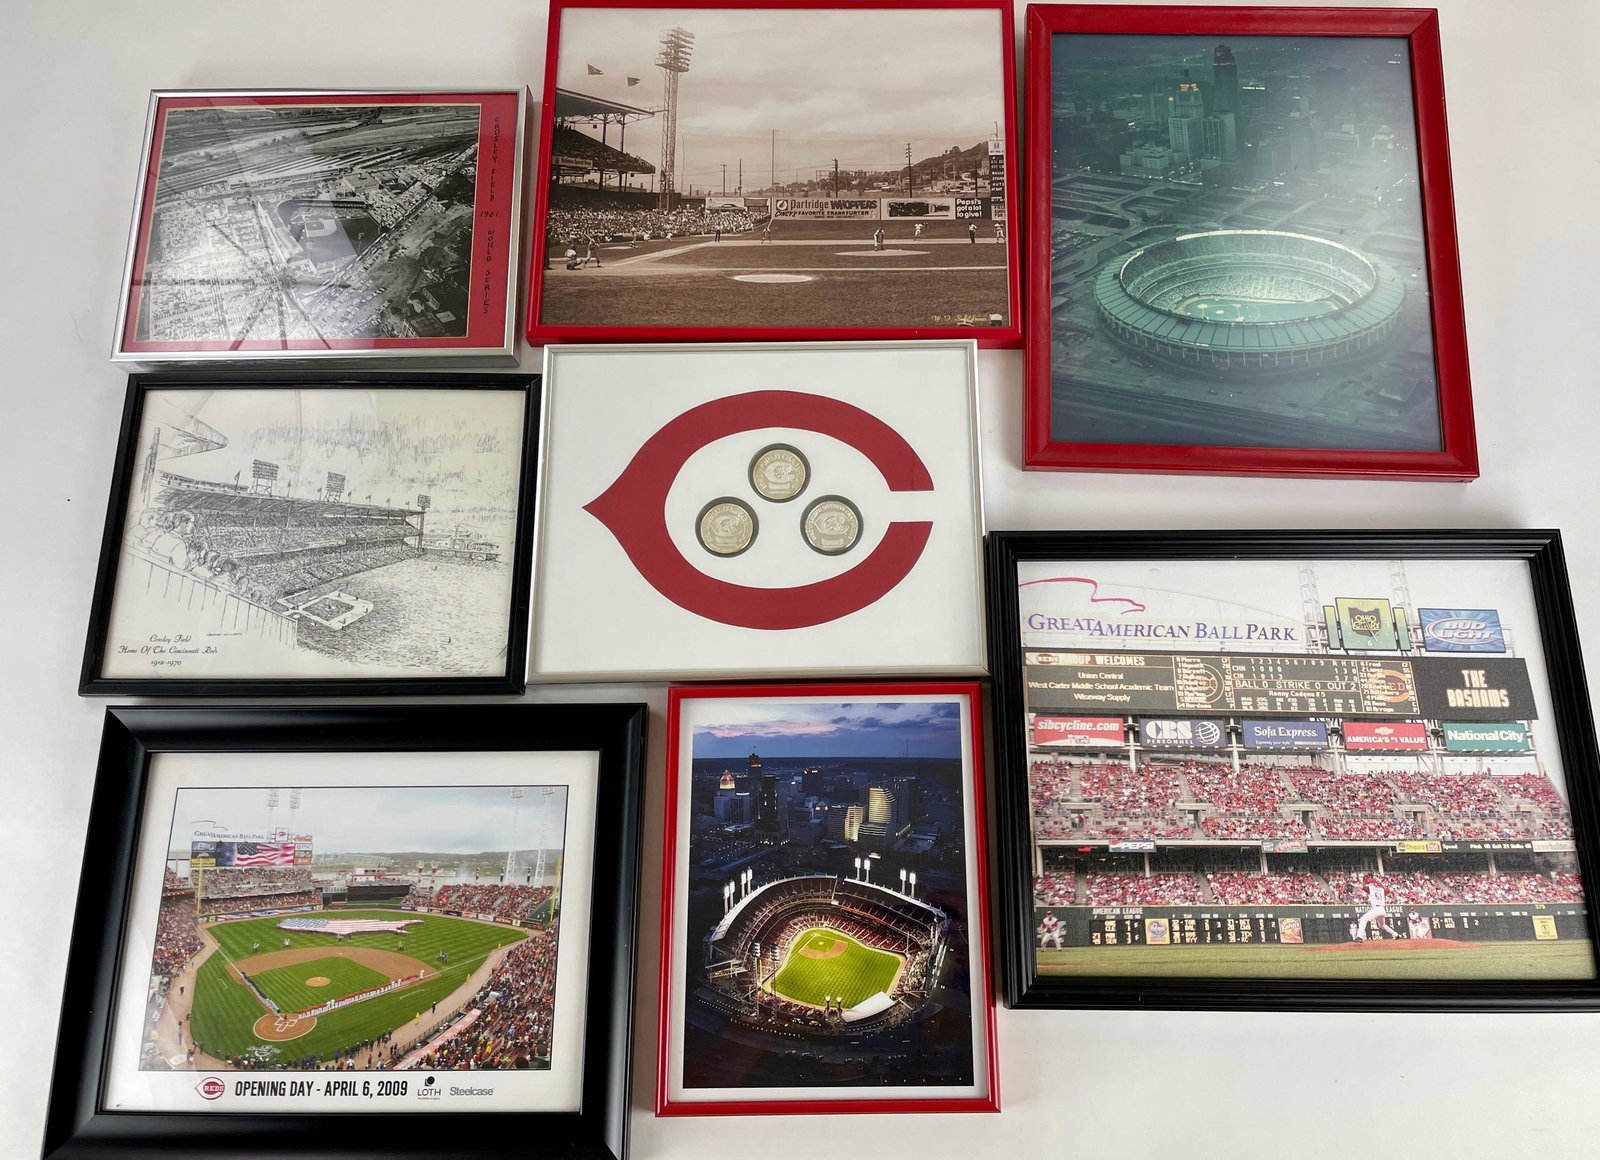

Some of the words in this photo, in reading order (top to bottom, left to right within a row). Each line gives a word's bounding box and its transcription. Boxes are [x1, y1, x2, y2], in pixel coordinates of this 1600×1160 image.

[489, 168, 497, 201] FIELD
[790, 200, 829, 210] Partridge
[480, 210, 499, 218] 1961
[486, 229, 495, 263] WORLD
[482, 268, 491, 314] SERIES
[1194, 622, 1244, 640] BALL
[1246, 624, 1296, 641] PARK
[1444, 621, 1487, 630] BUD
[150, 635, 171, 643] Crosley
[1437, 630, 1495, 640] LIGHT
[118, 646, 138, 654] Home
[140, 646, 152, 655] Of
[1095, 655, 1146, 666] WELCOMES
[1462, 670, 1488, 688] THE
[1106, 694, 1131, 702] Supply
[1446, 689, 1510, 707] BASHAMS
[1037, 720, 1120, 732] sibcycline.com
[1145, 720, 1193, 740] CBS
[1254, 726, 1276, 738] Sofa
[235, 1081, 286, 1096] OPENING
[290, 1081, 314, 1096] DAY
[324, 1081, 358, 1096] APRIL
[362, 1081, 373, 1098] 6,
[377, 1080, 408, 1096] 2009
[450, 1087, 493, 1096] Steelcase
